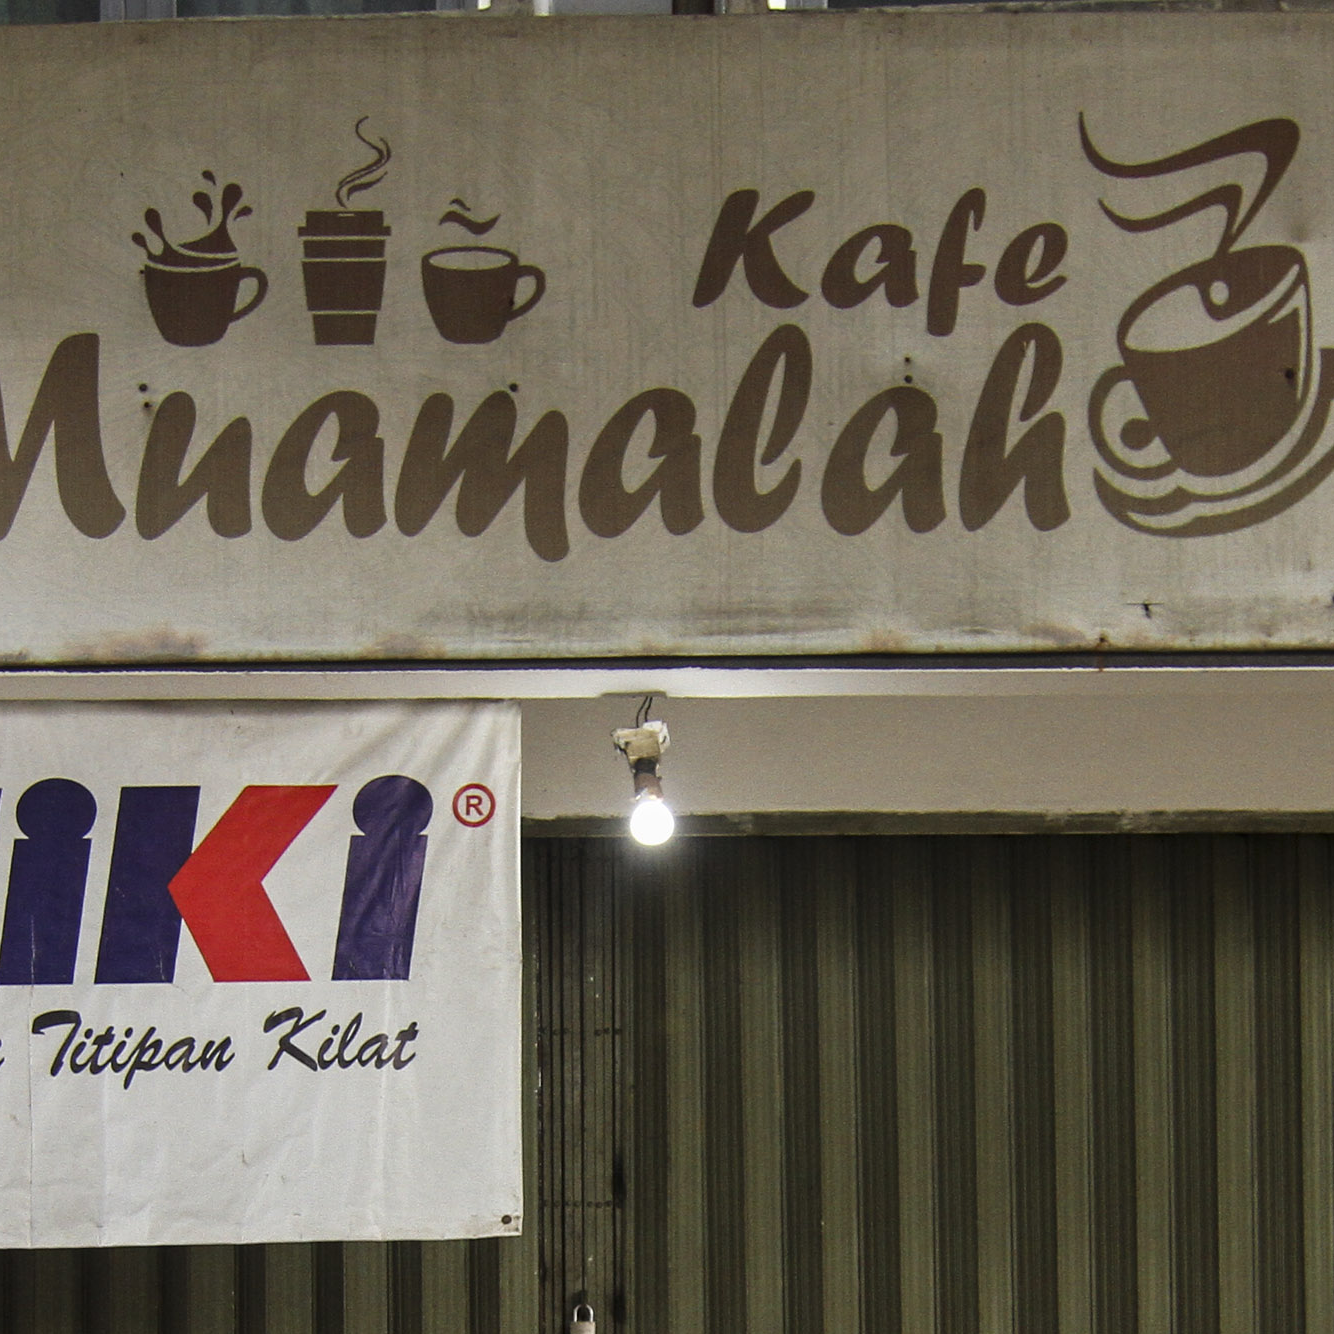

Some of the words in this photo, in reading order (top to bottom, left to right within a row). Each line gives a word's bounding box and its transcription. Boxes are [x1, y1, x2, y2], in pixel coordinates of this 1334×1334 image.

[692, 187, 1068, 337] Kafe
[31, 1009, 236, 1091] Titipan
[263, 1006, 420, 1072] Kilat
